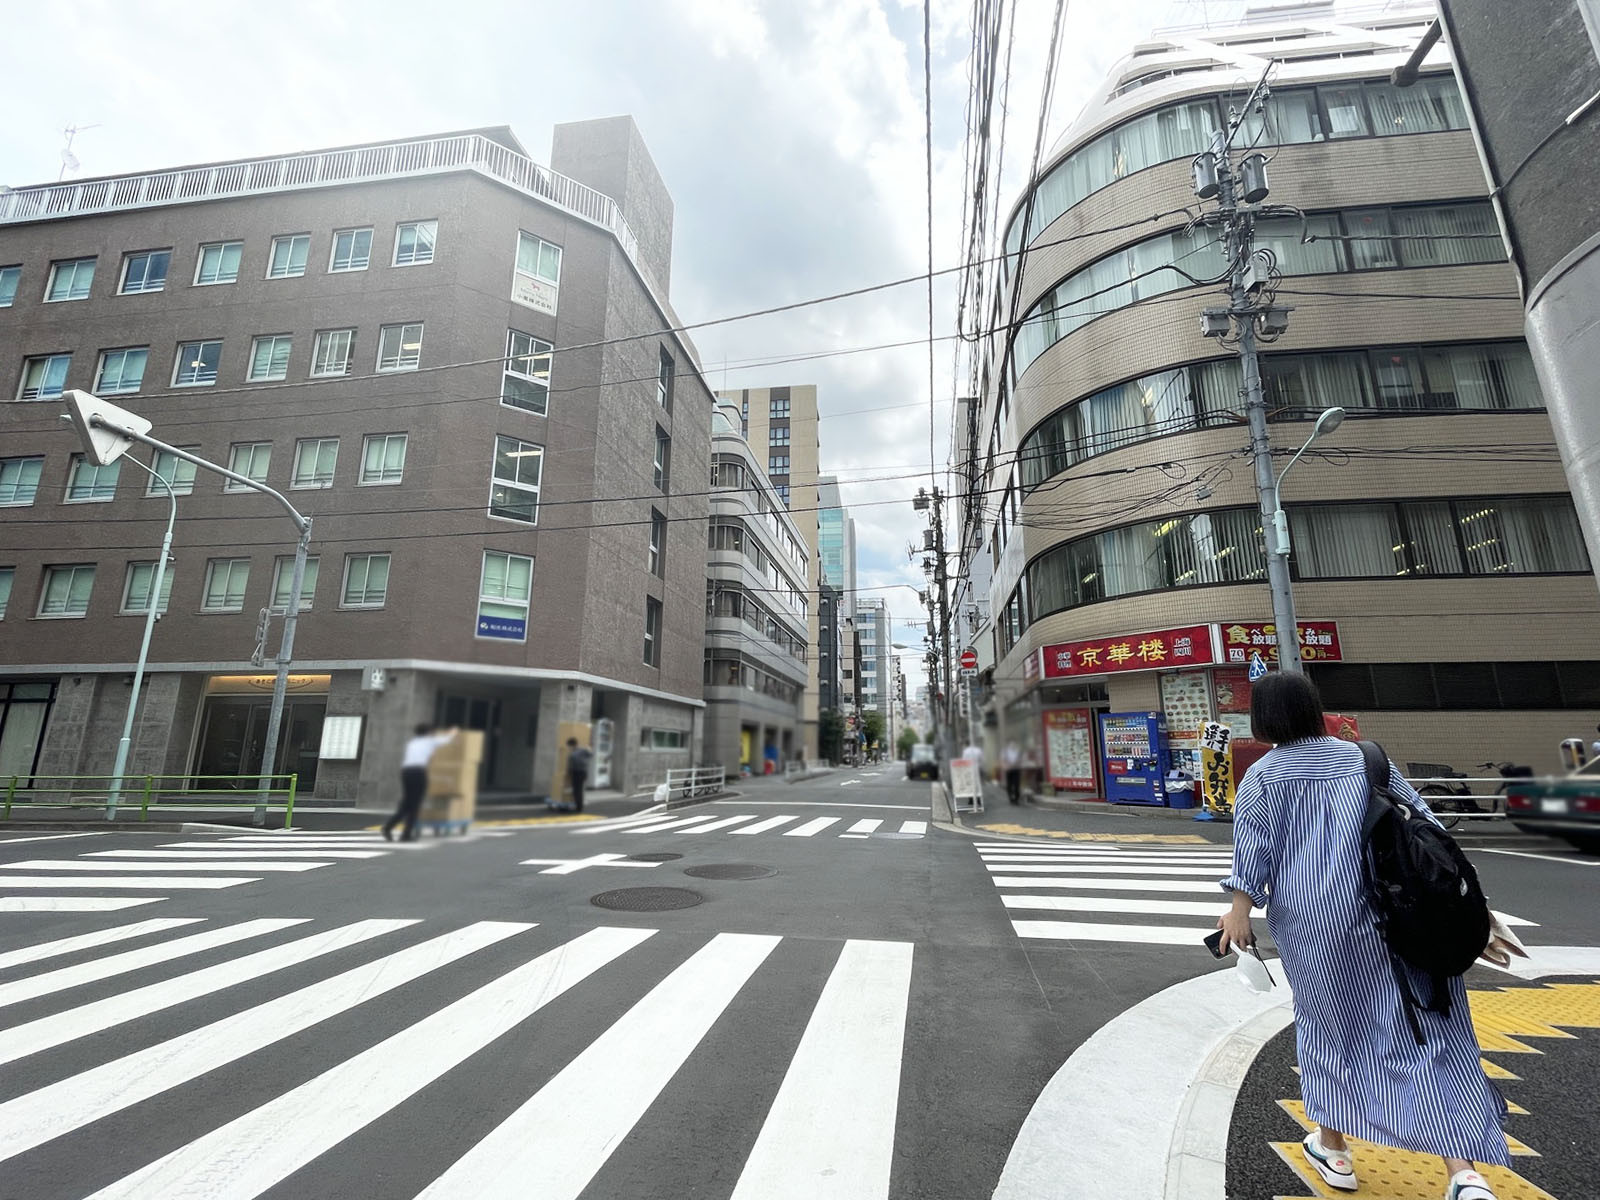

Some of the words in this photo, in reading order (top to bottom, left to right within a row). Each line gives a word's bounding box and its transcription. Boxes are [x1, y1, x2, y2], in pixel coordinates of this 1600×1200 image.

[1297, 627, 1333, 645] み放題
[1076, 639, 1169, 668] 京華楼
[1230, 649, 1244, 658] 70
[1206, 751, 1232, 816] お弁当
